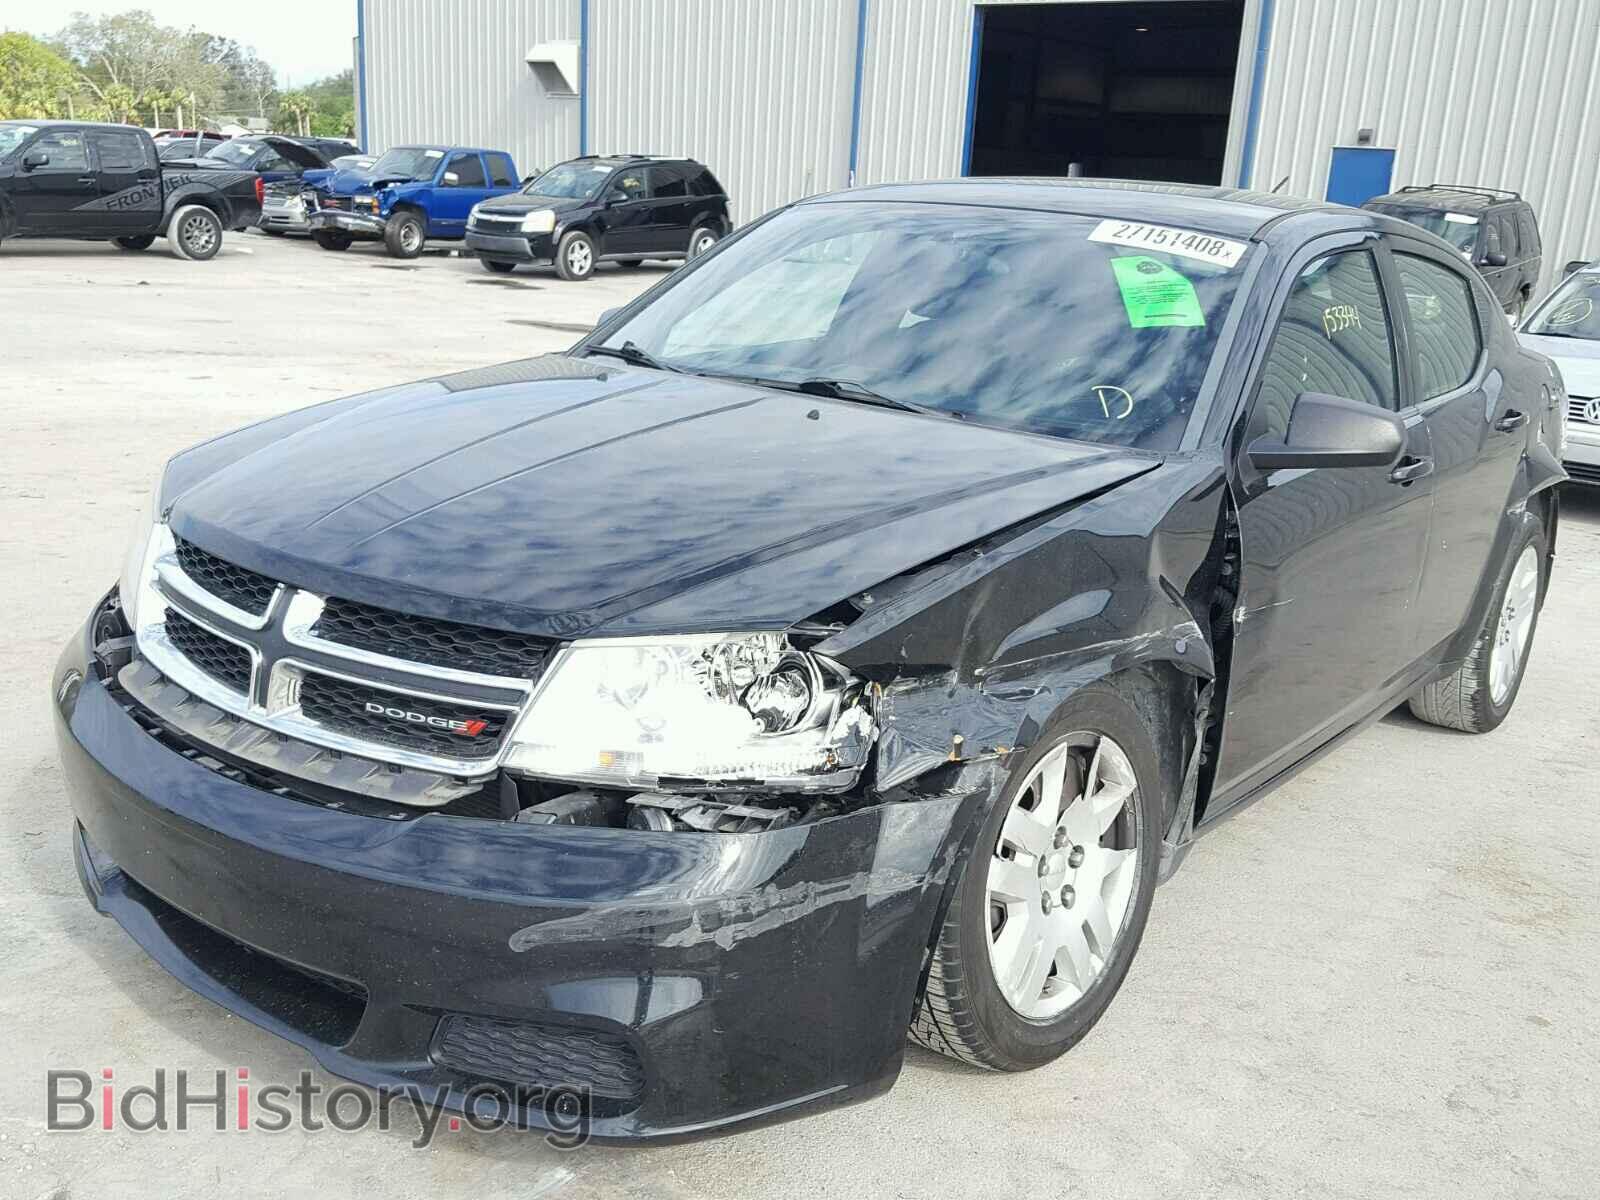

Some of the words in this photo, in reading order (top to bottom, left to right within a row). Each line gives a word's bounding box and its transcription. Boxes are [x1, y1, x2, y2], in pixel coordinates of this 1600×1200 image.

[106, 174, 191, 210] FRONIER
[1112, 223, 1225, 257] 27151408
[1091, 385, 1133, 419] D
[365, 702, 469, 732] DODGE
